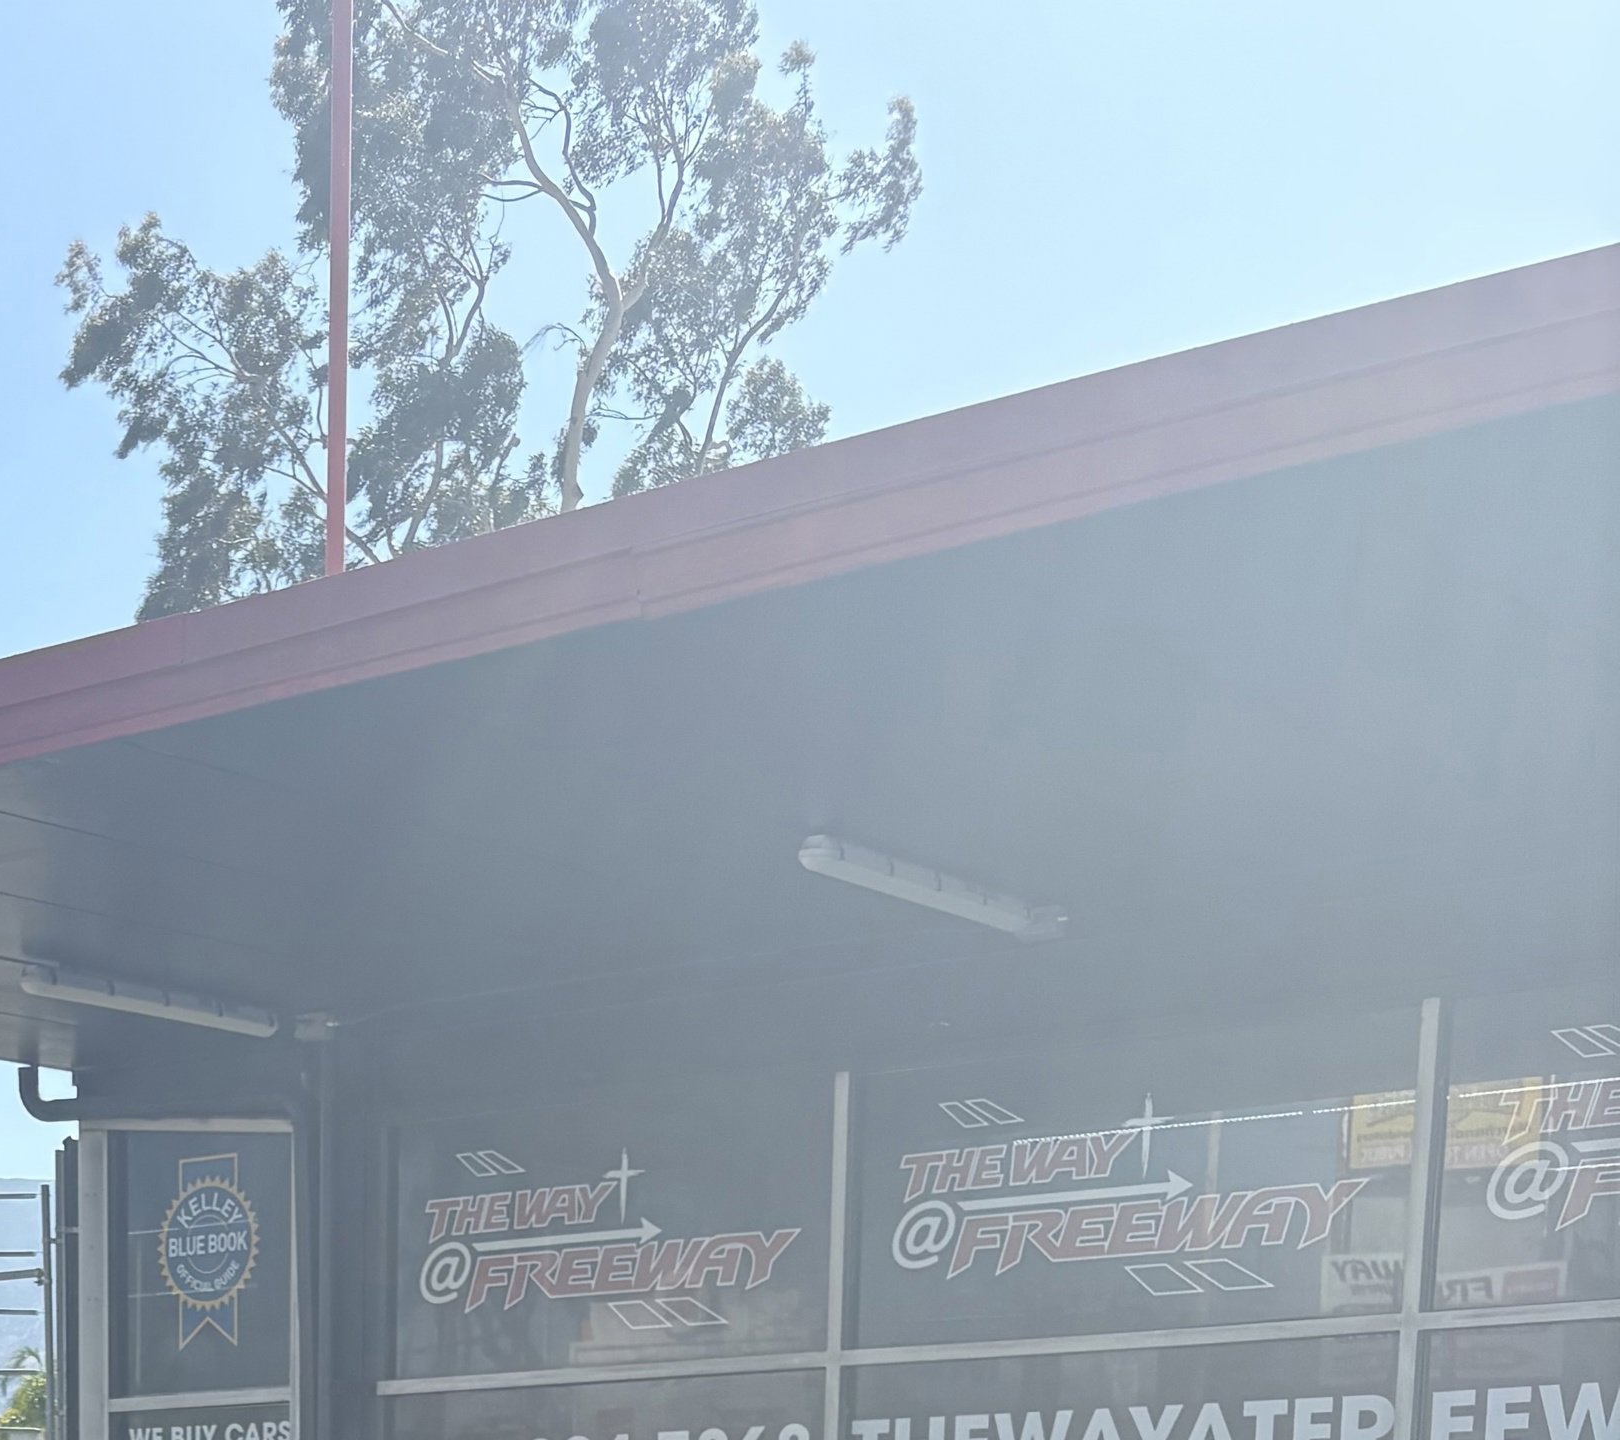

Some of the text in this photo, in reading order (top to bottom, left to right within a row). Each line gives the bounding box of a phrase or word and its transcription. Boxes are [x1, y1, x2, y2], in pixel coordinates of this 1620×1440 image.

[177, 1192, 243, 1228] KELLEY
[168, 1230, 248, 1258] BLUE BOOK
[176, 1259, 240, 1292] OFFICIAL GUIDE
